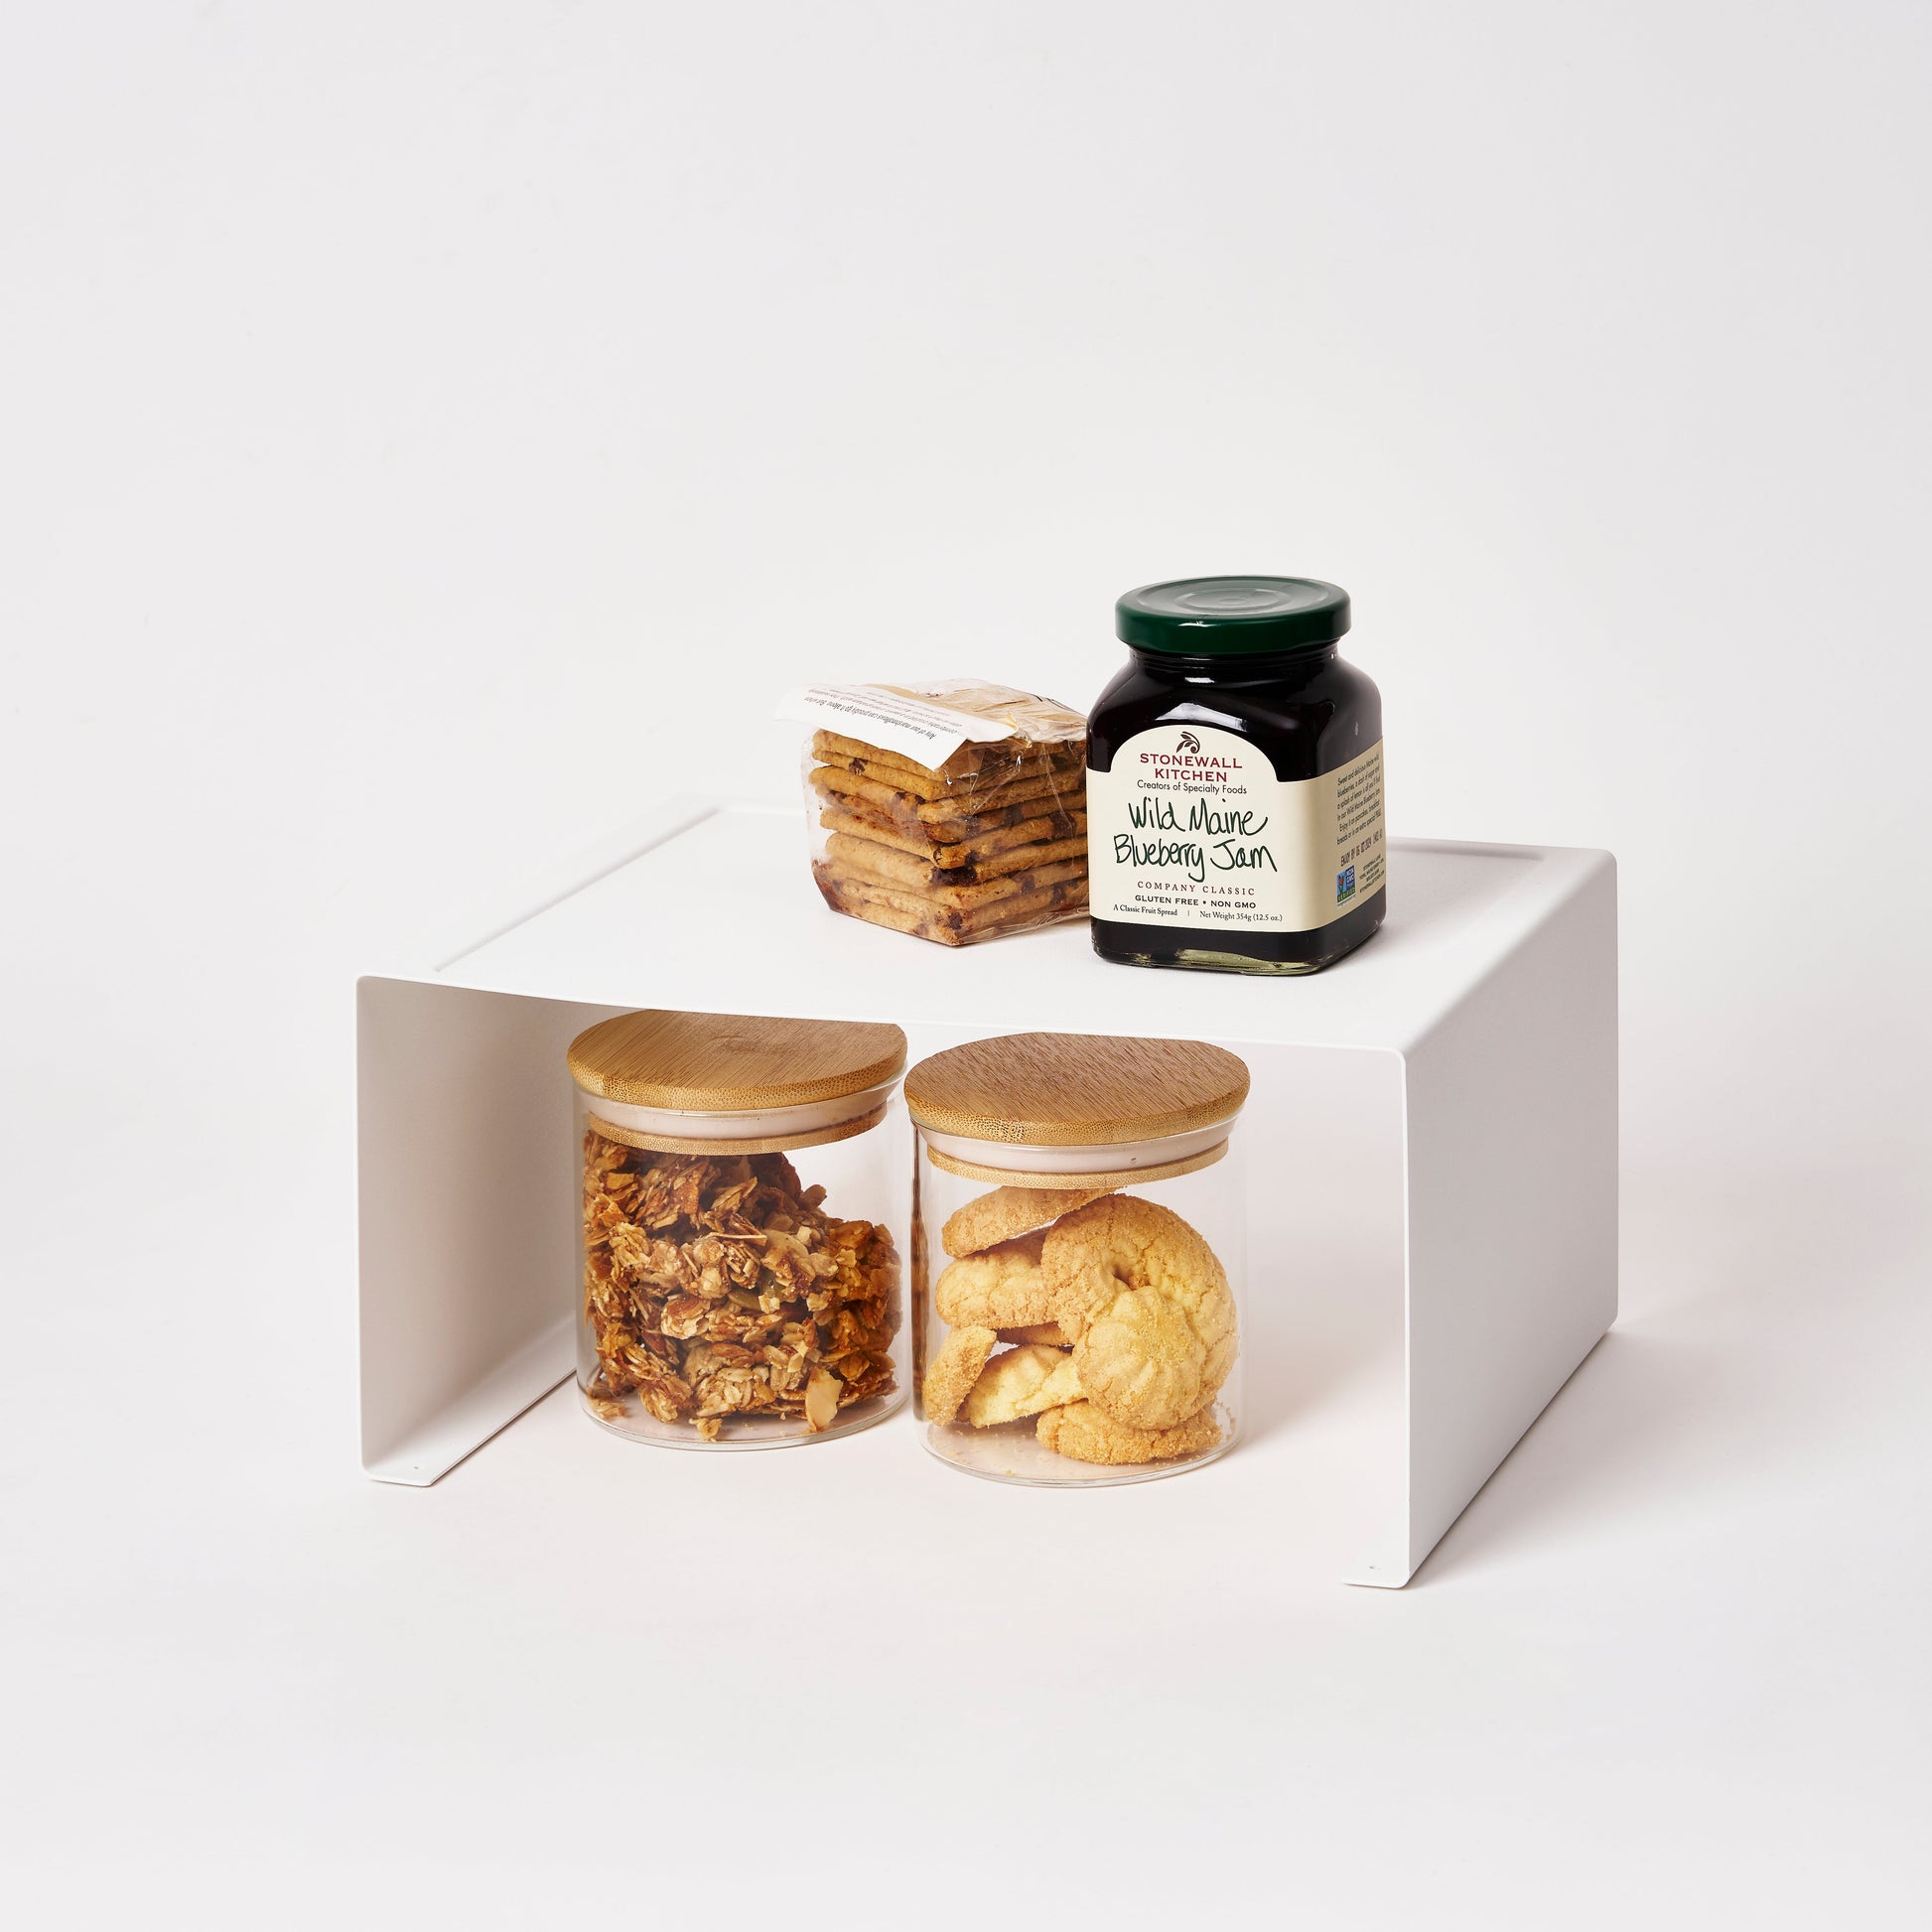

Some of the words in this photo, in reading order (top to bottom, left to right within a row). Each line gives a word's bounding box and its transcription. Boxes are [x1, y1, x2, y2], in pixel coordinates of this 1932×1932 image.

[1140, 754, 1243, 768] STONEWALL
[1155, 768, 1227, 782] KITCHEN
[1137, 779, 1171, 793] Creators
[1173, 781, 1181, 792] of
[1182, 782, 1220, 795] Specialty
[1222, 784, 1247, 794] Foods
[1128, 796, 1185, 832] Wild
[1189, 798, 1269, 836] Maine
[1113, 834, 1204, 883] Blueberry
[1210, 838, 1278, 872] Jam
[1137, 881, 1195, 893] COMPANY
[1202, 886, 1255, 896] CLASSIC
[1135, 895, 1172, 904] GLUTEN
[1120, 904, 1140, 914] Classic
[1142, 906, 1157, 915] Fruit
[1158, 908, 1177, 918] Spread
[1212, 911, 1235, 921] Weight
[1236, 912, 1252, 922] 354g
